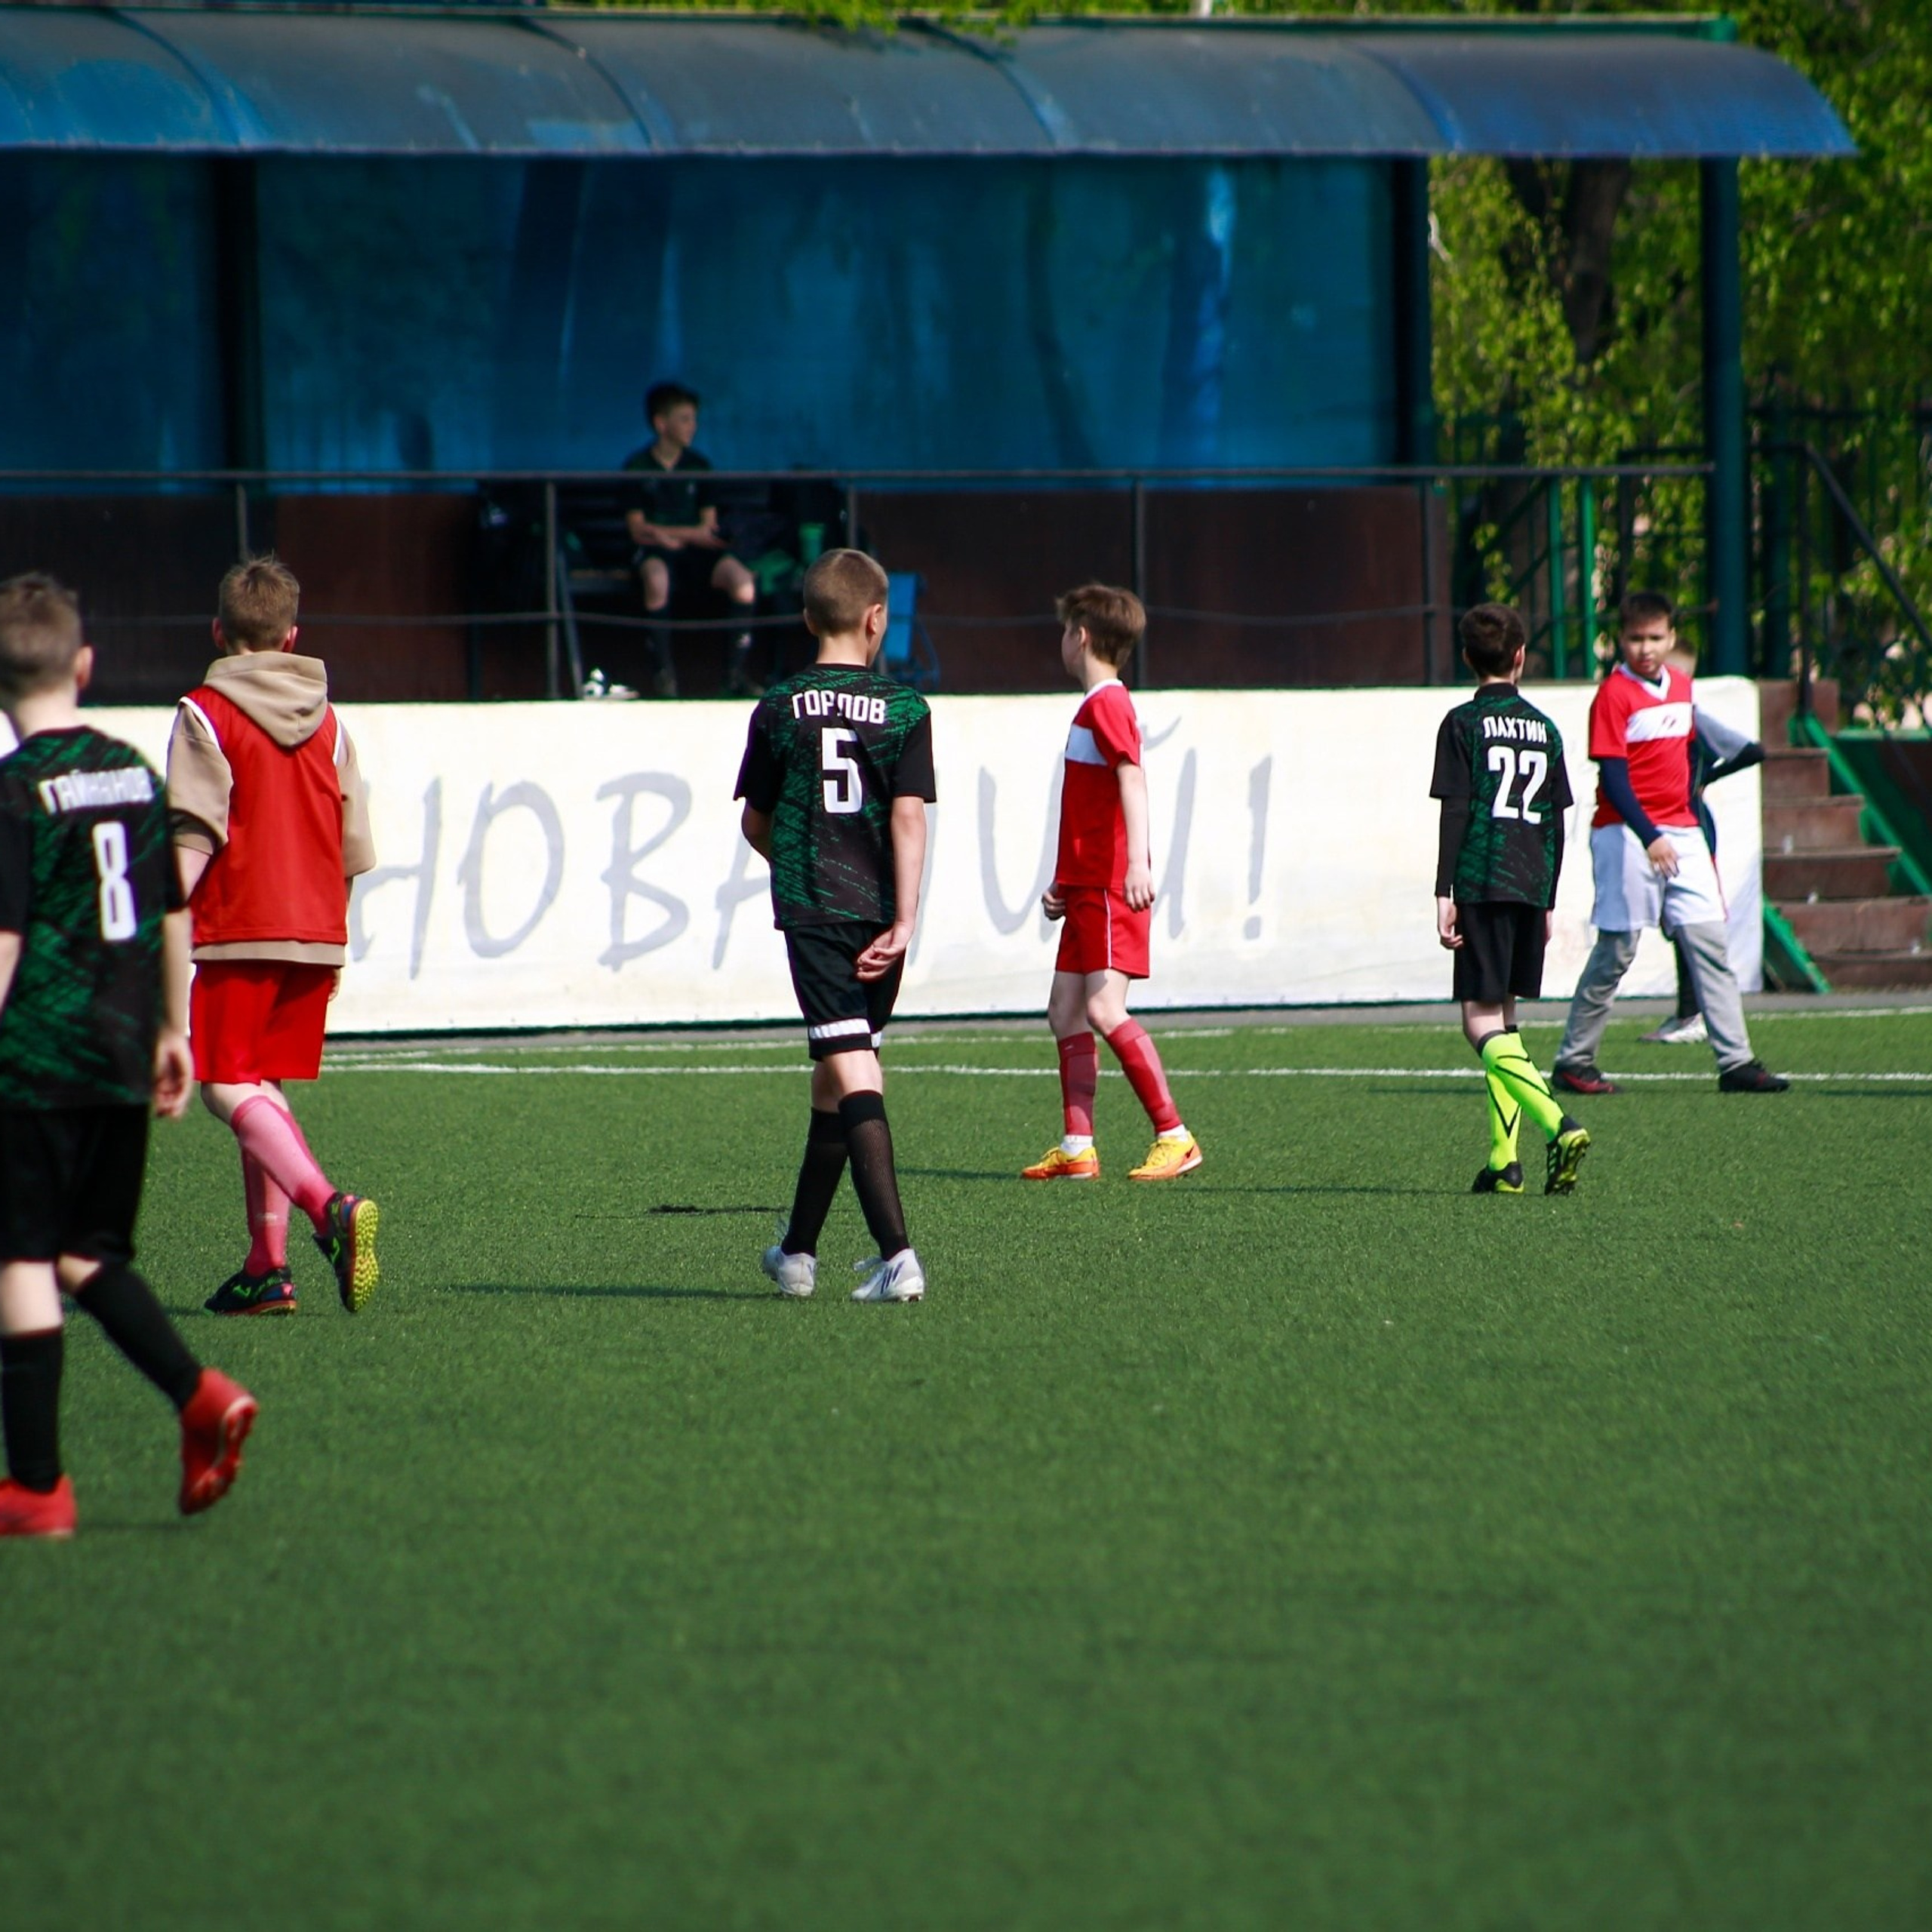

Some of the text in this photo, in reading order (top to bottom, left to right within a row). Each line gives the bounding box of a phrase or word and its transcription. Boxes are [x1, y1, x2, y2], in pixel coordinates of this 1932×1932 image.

[792, 690, 885, 724] ГОРЛОВ
[1483, 715, 1547, 743] ЛАХТИН
[822, 728, 863, 813] 5
[1487, 745, 1547, 824] 22
[93, 821, 137, 940] 8
